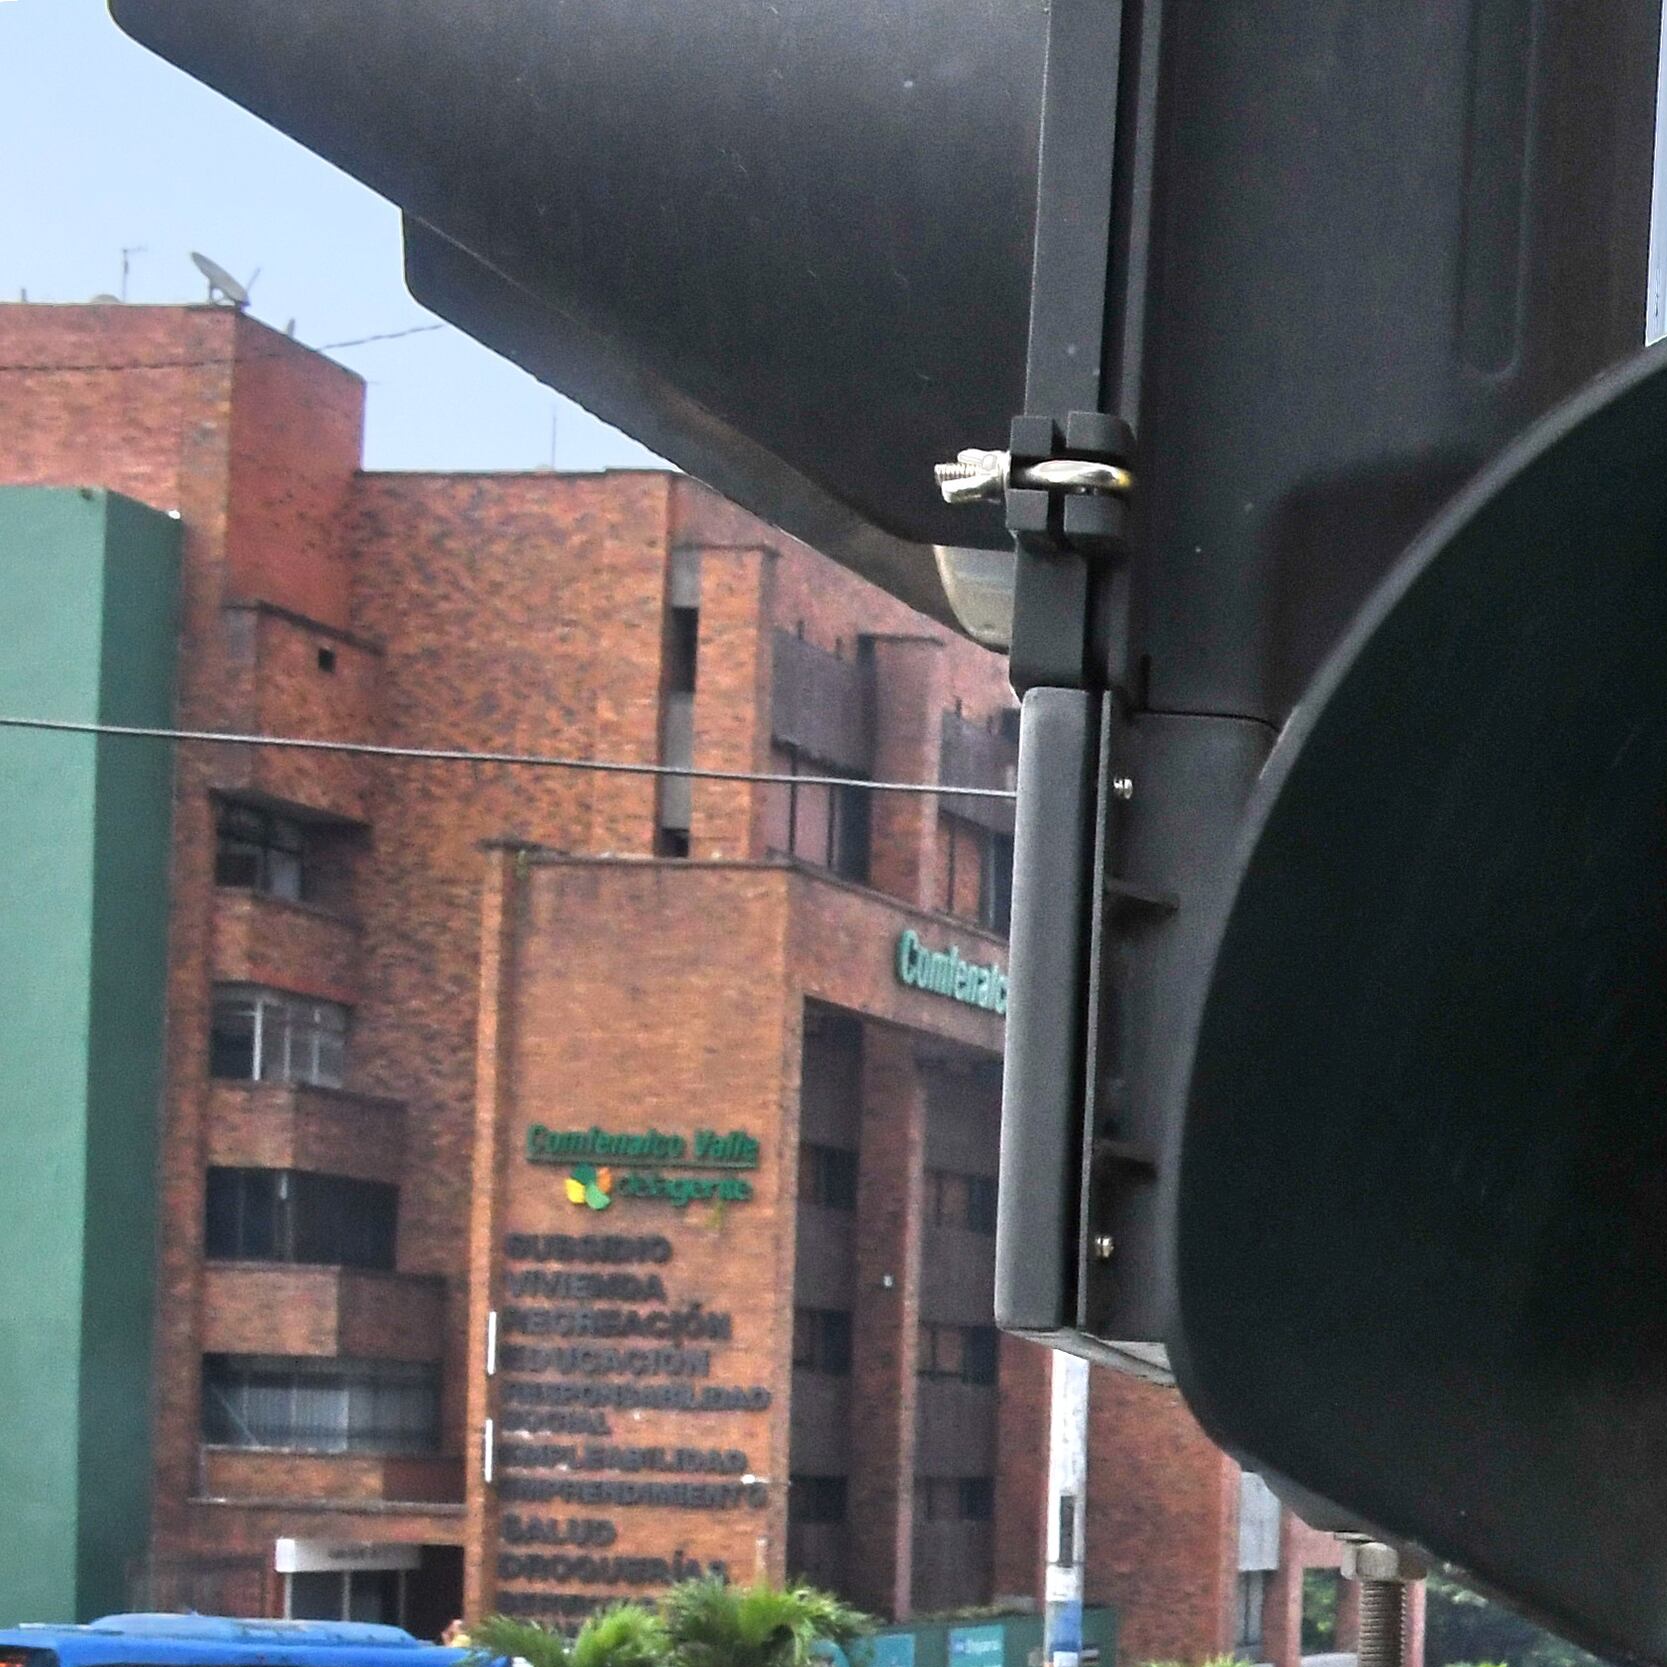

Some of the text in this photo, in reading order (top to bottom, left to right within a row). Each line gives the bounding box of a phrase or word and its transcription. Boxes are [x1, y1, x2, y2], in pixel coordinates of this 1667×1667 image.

[899, 929, 1008, 1015] Comfenalc
[695, 1129, 758, 1160] Valle
[504, 1270, 667, 1300] VIVIENDA
[503, 1513, 617, 1547] SALUD
